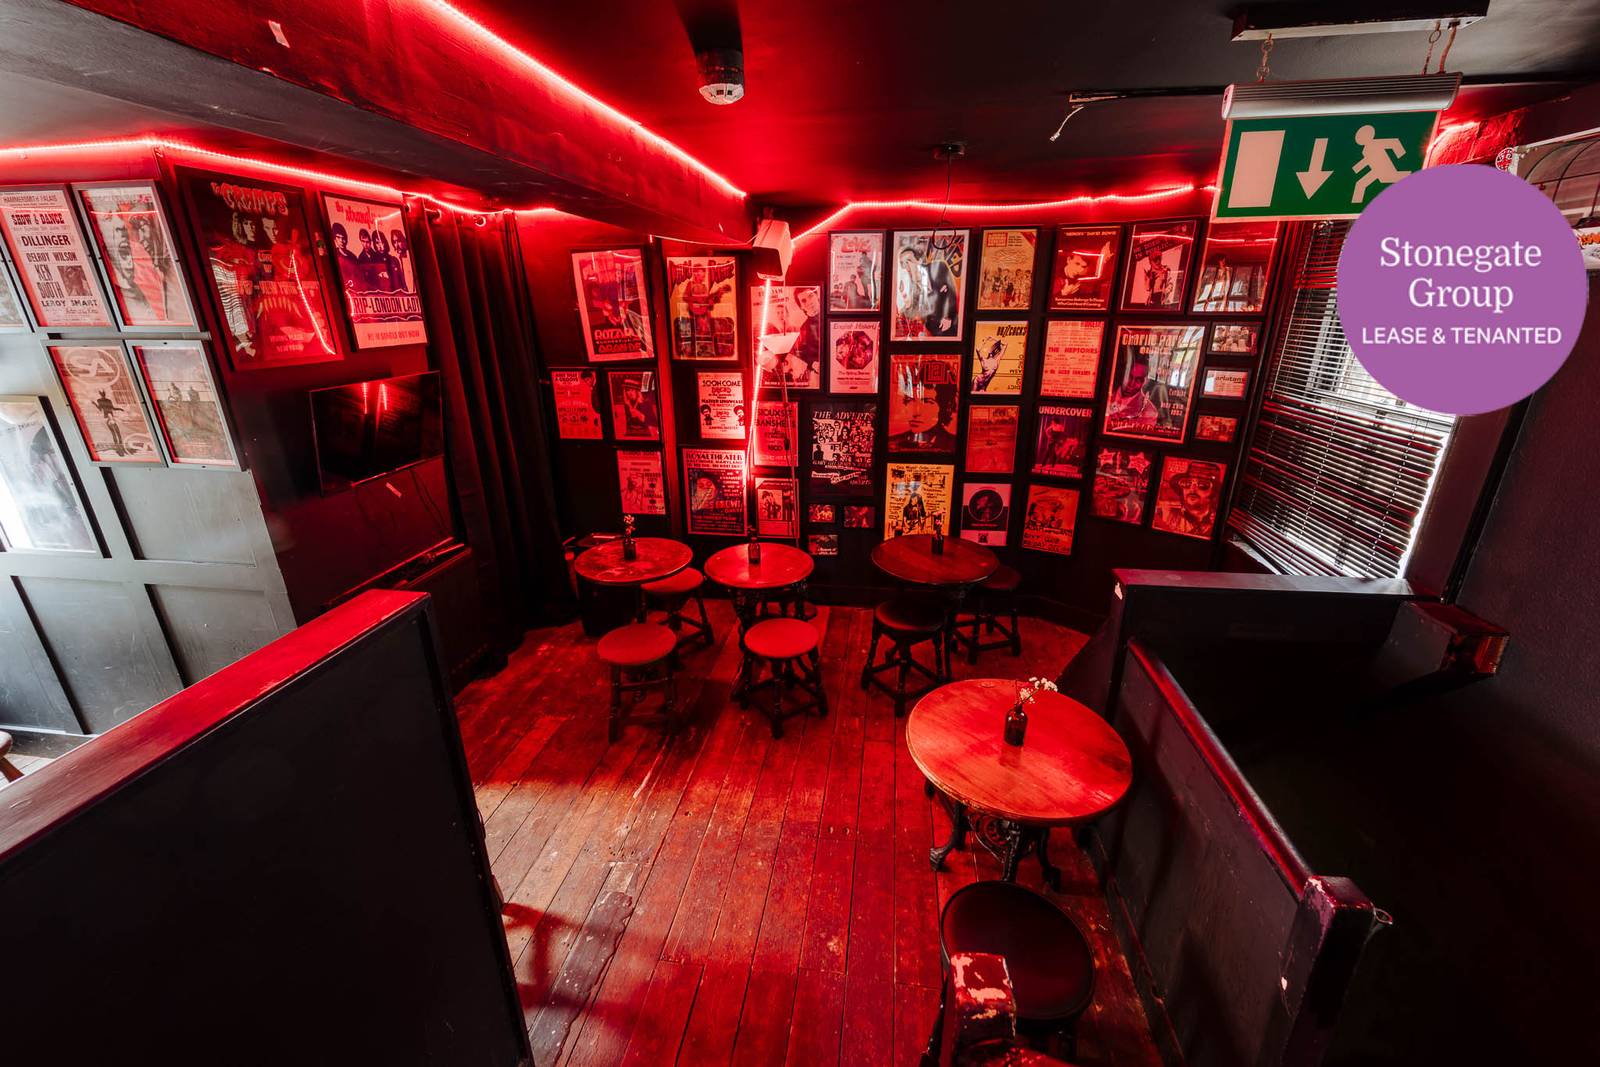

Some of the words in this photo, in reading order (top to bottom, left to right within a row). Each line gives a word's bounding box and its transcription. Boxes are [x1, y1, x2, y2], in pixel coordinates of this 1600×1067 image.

[12, 213, 32, 225] SHOW
[40, 213, 65, 225] DANCE
[21, 234, 71, 247] DILLINGER
[26, 252, 50, 262] DELROY
[52, 251, 78, 261] WILSON
[34, 264, 53, 281] KEN
[36, 281, 65, 299] BOOTH
[40, 300, 66, 308] LEROY
[71, 299, 98, 307] SMART
[813, 411, 833, 419] THE
[835, 411, 876, 420] ADVERTS
[1038, 405, 1092, 418] UNDERCOVER
